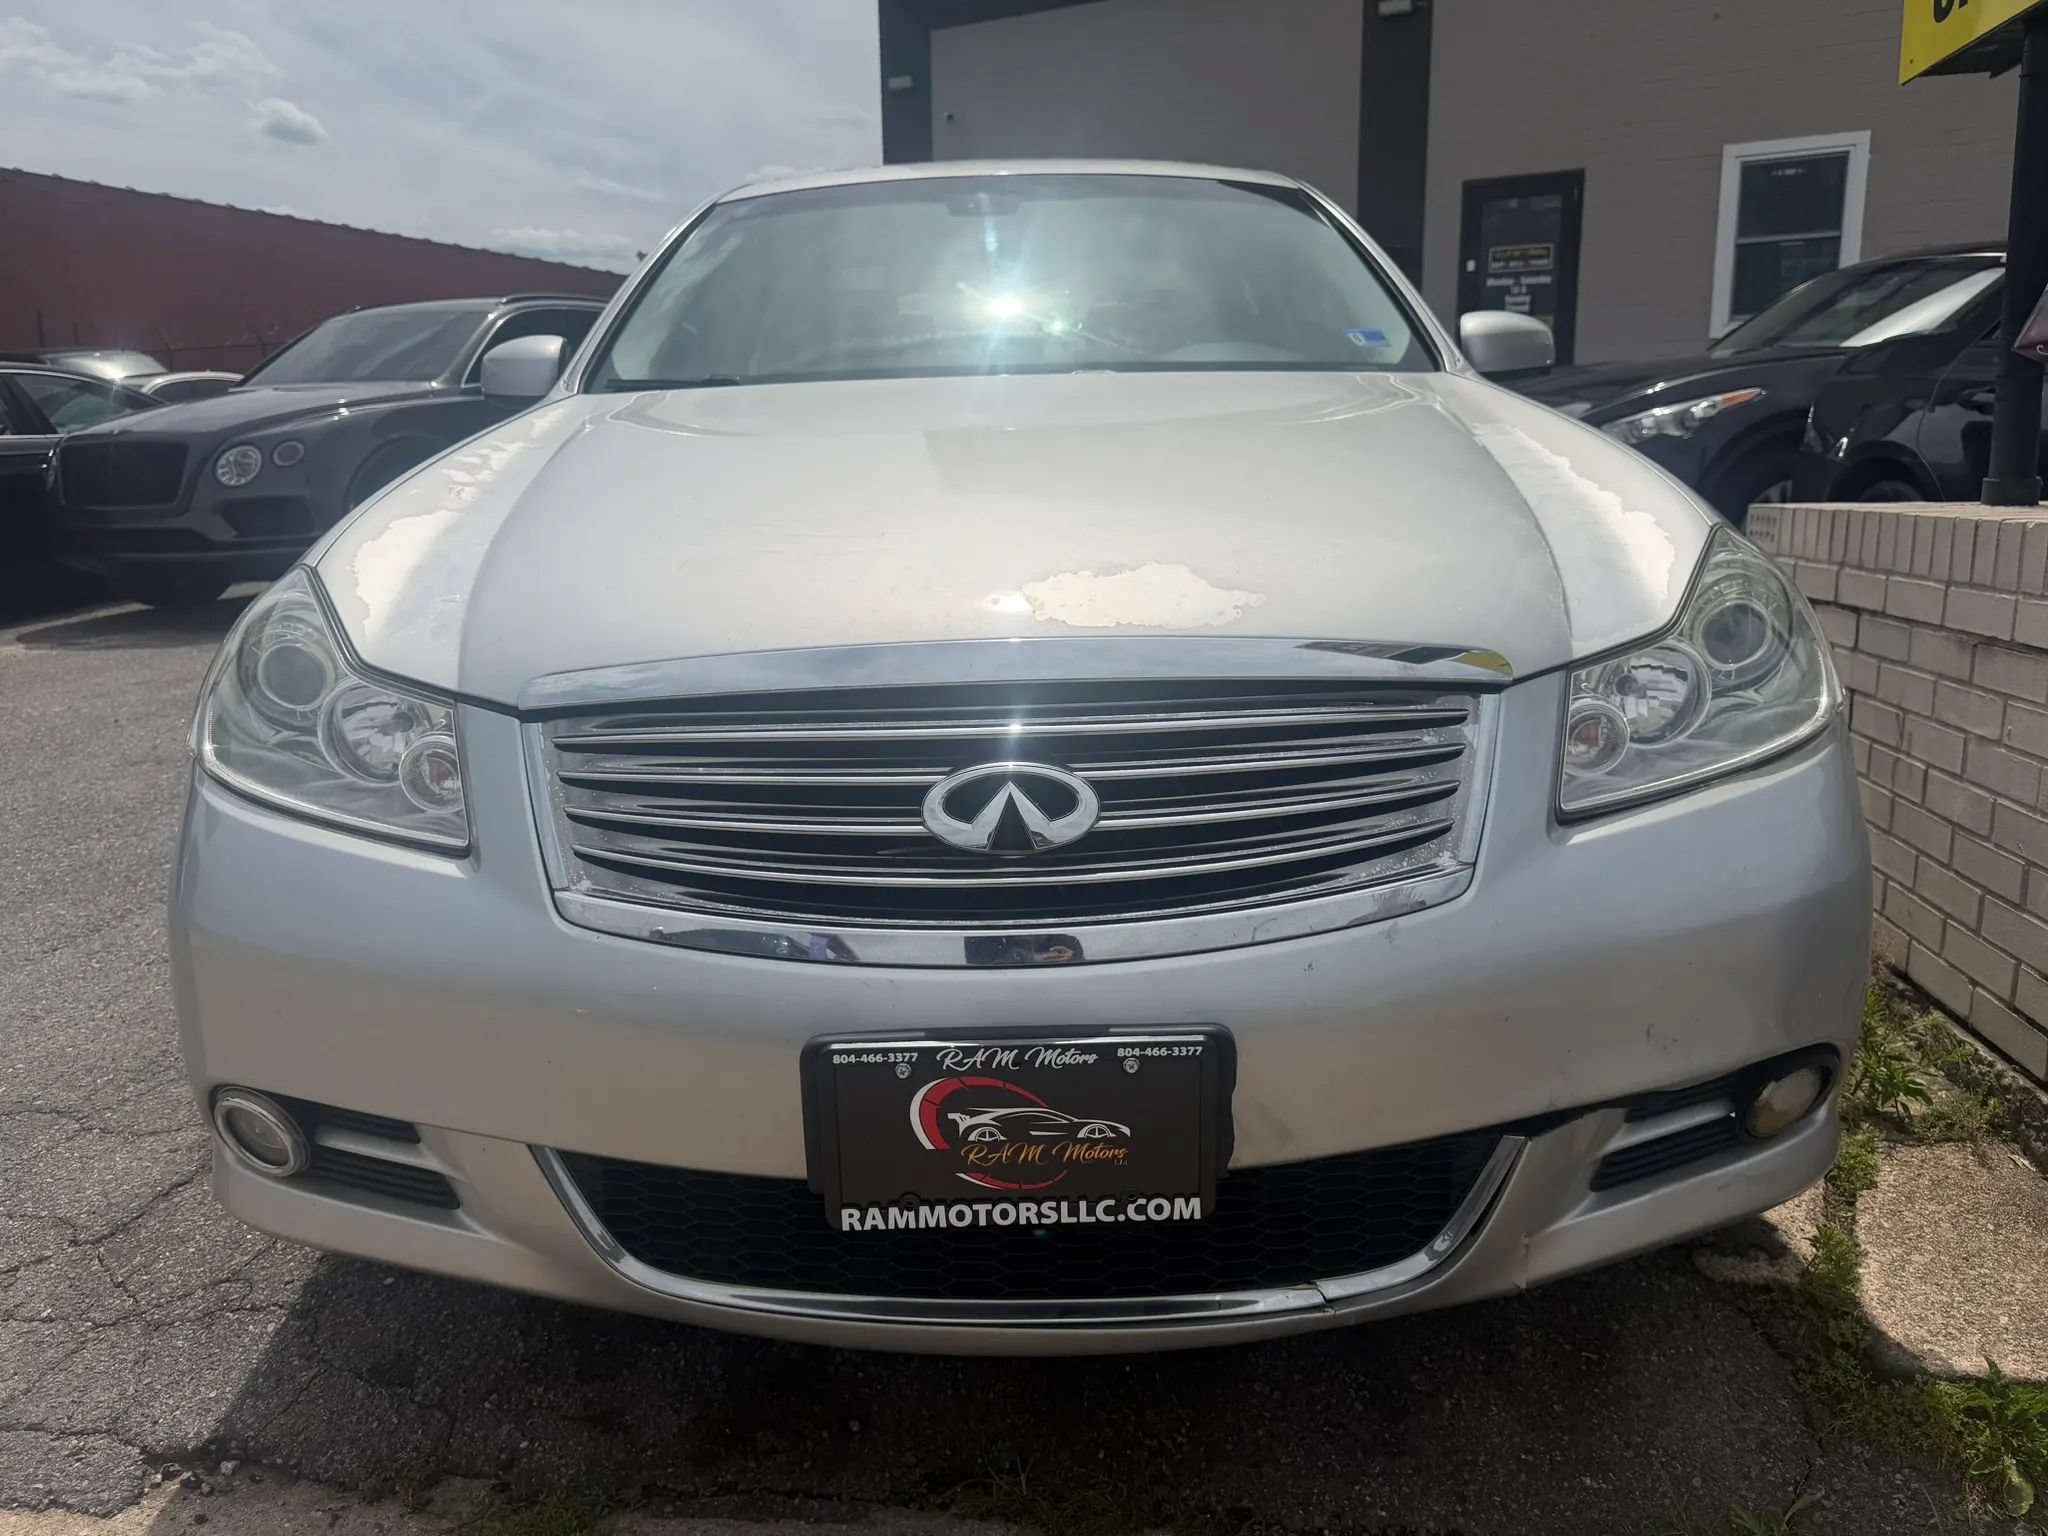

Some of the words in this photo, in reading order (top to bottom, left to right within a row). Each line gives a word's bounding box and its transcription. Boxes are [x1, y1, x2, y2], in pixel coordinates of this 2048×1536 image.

[832, 1052, 918, 1064] 804-466-3377
[936, 1047, 1020, 1071] RAM
[1024, 1046, 1099, 1069] Motors
[1117, 1046, 1203, 1057] 804-466-3377
[960, 1142, 1049, 1167] RAM
[1052, 1141, 1129, 1164] Motors
[841, 1197, 1201, 1232] RAMMOTORSLLC.COM
